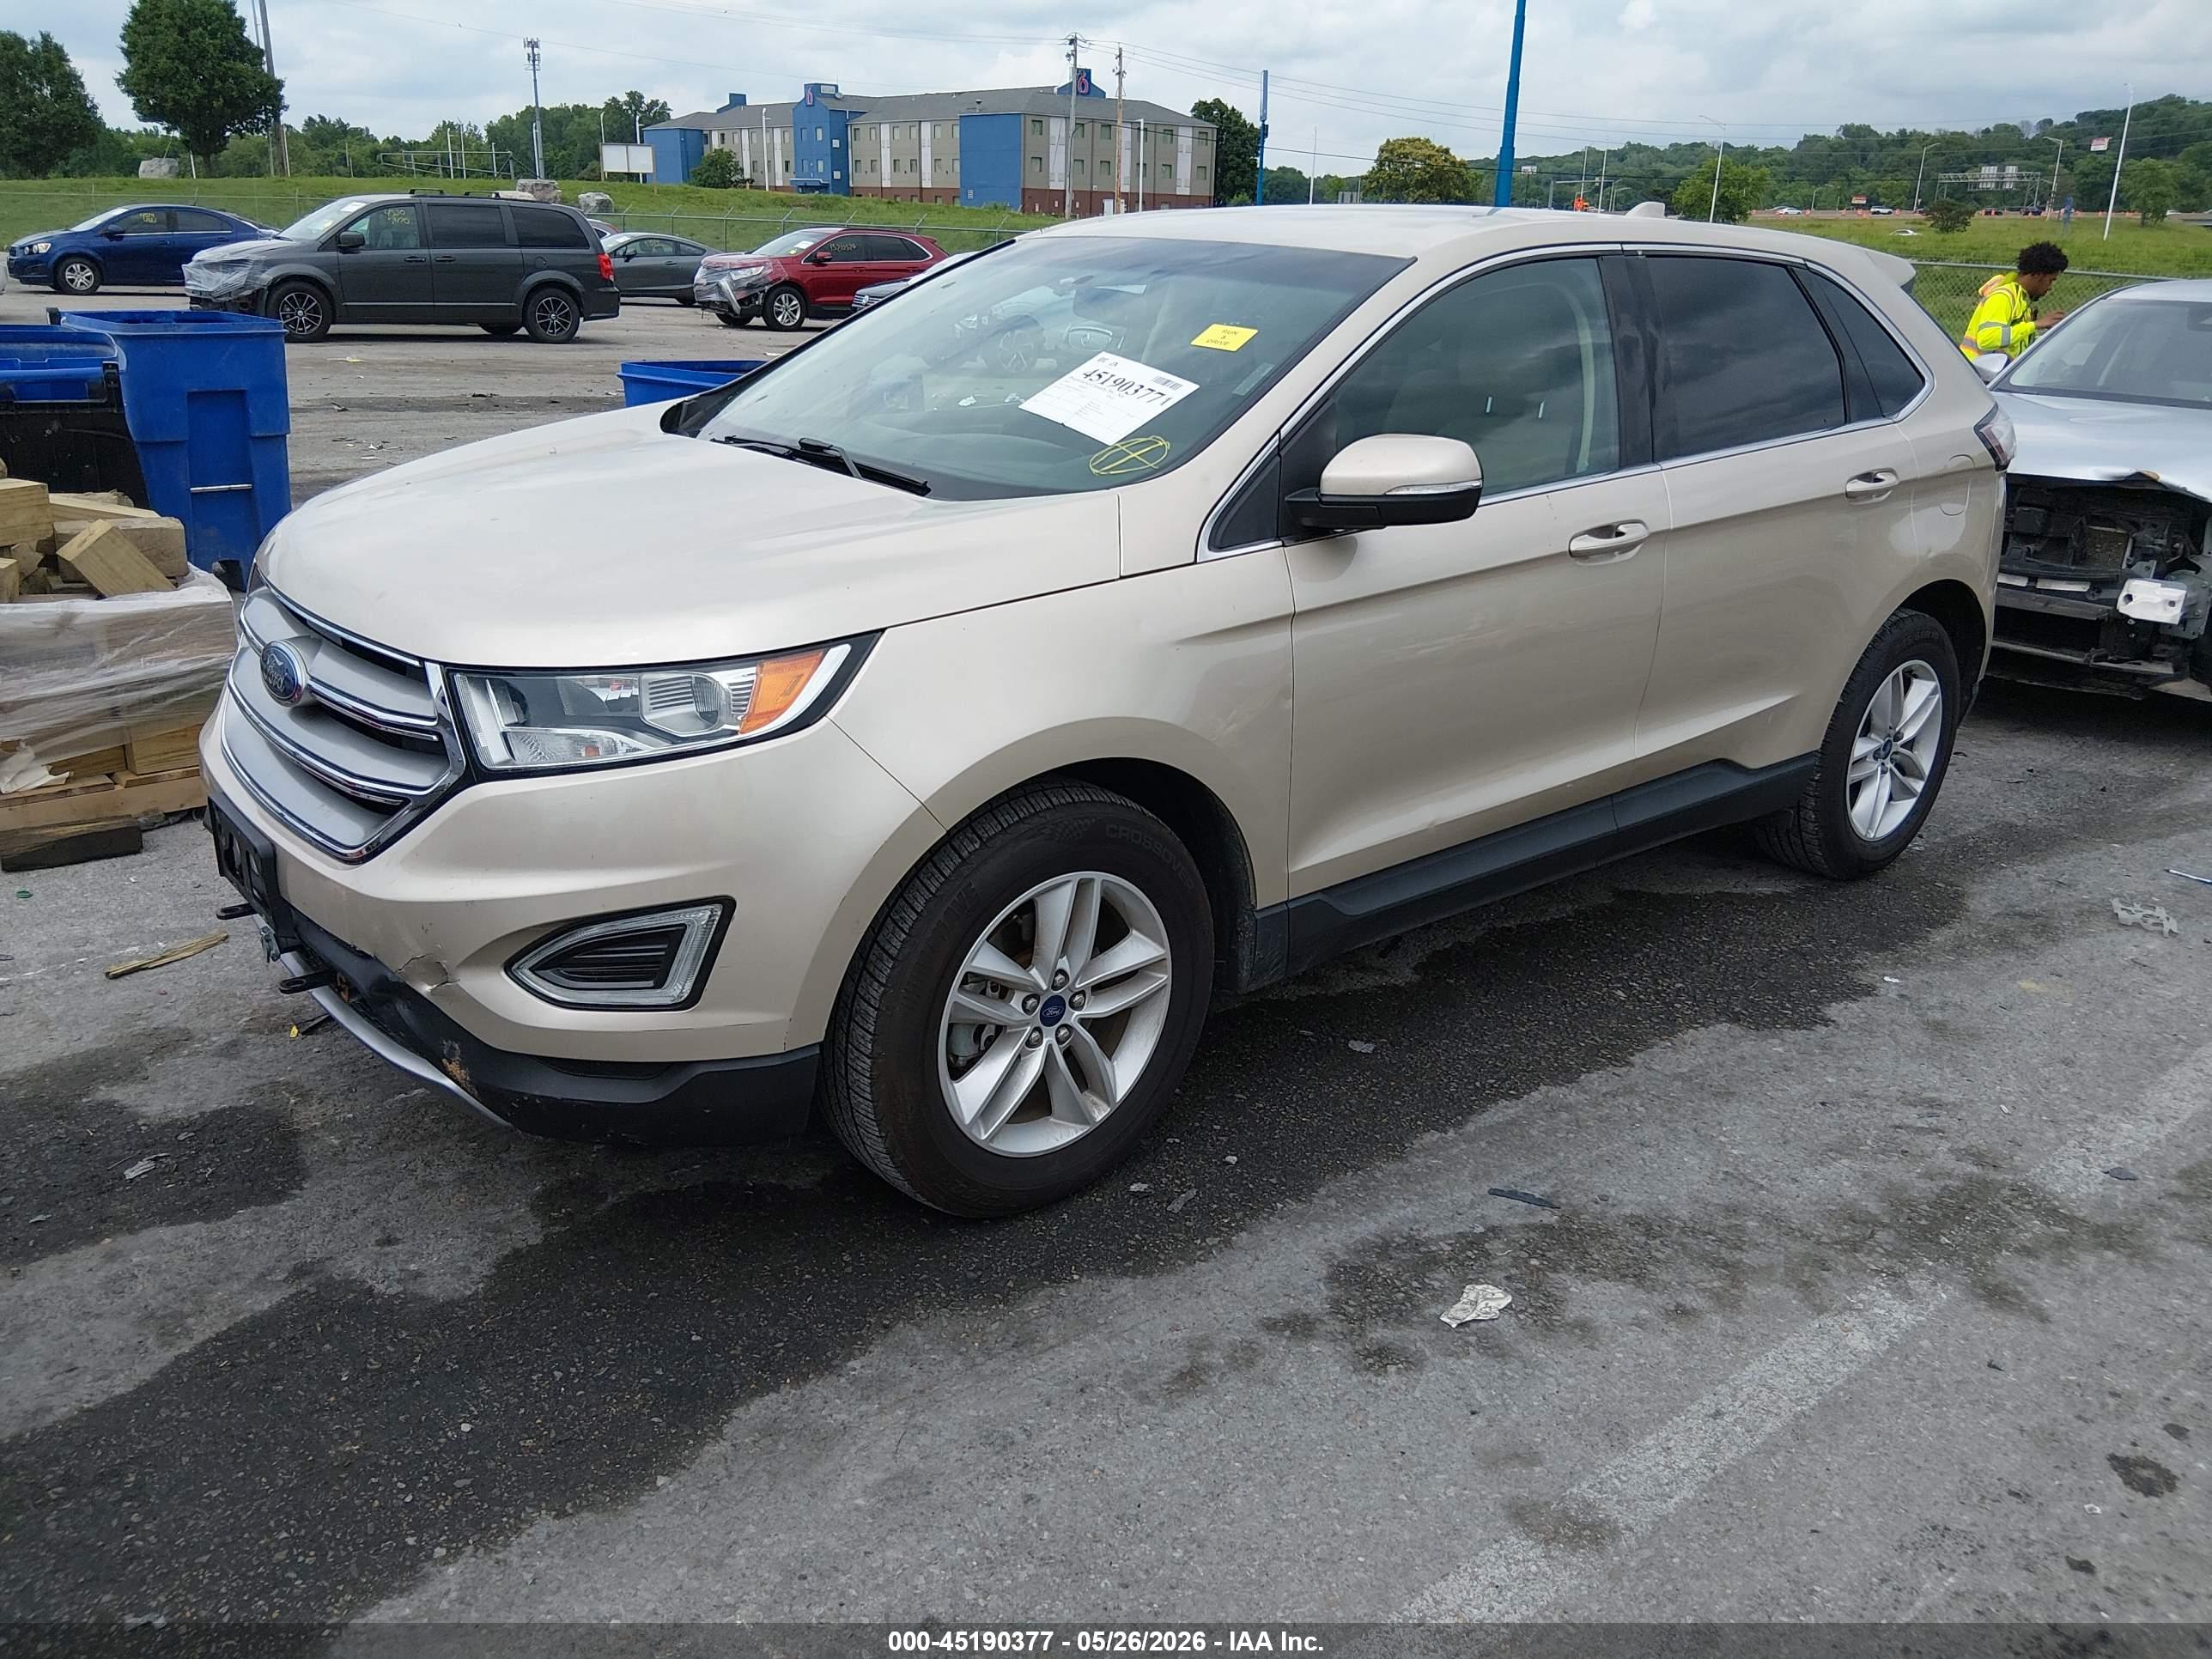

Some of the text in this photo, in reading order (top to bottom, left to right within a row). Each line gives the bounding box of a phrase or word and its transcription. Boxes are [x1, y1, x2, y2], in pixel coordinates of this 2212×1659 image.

[1076, 70, 1089, 94] 6
[805, 87, 813, 106] 6
[1105, 824, 1195, 890] CROSSOVER
